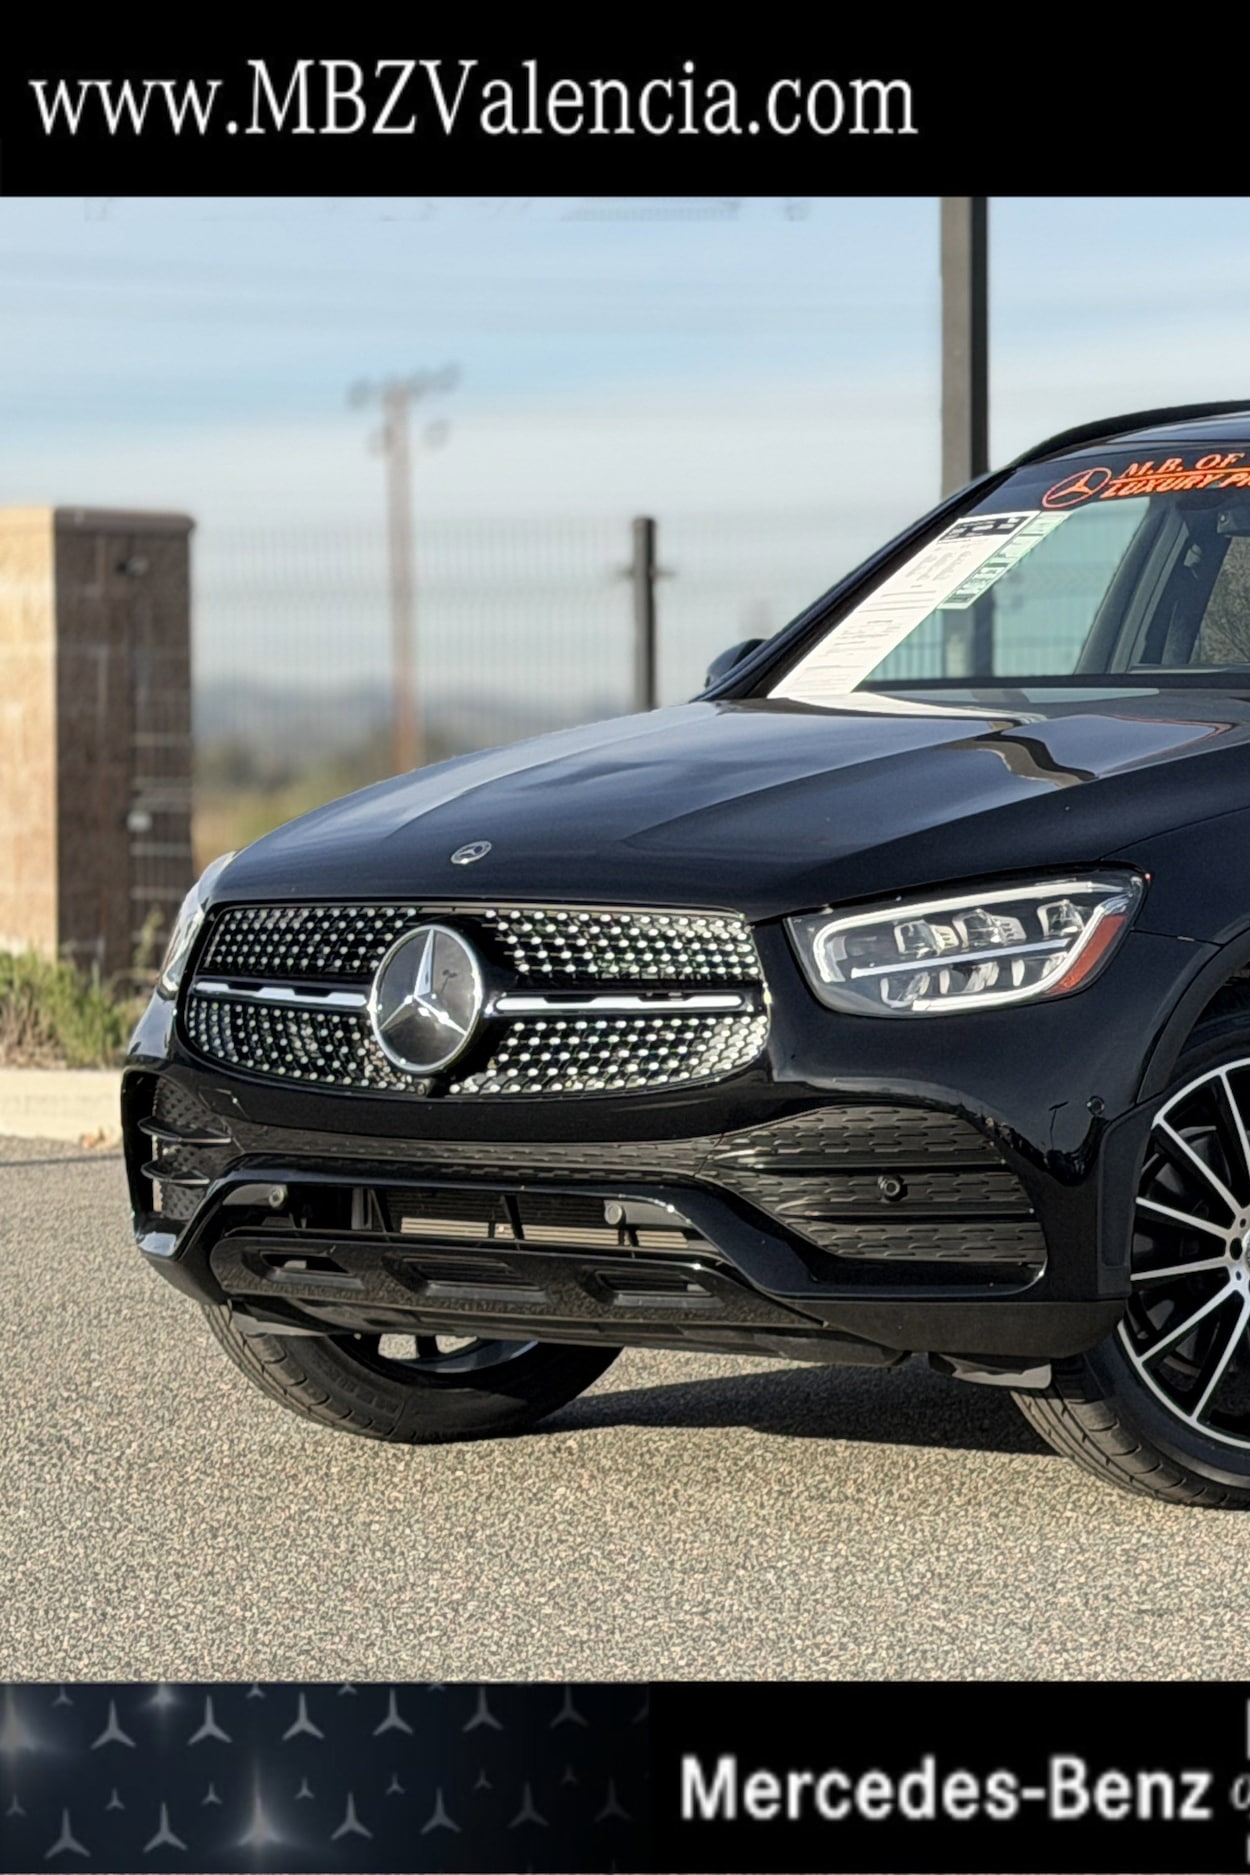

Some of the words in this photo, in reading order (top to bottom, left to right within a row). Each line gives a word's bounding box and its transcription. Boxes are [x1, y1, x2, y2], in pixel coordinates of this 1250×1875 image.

[1123, 457, 1183, 478] M.B.
[1196, 452, 1245, 470] OF
[1100, 472, 1221, 499] LUXURY
